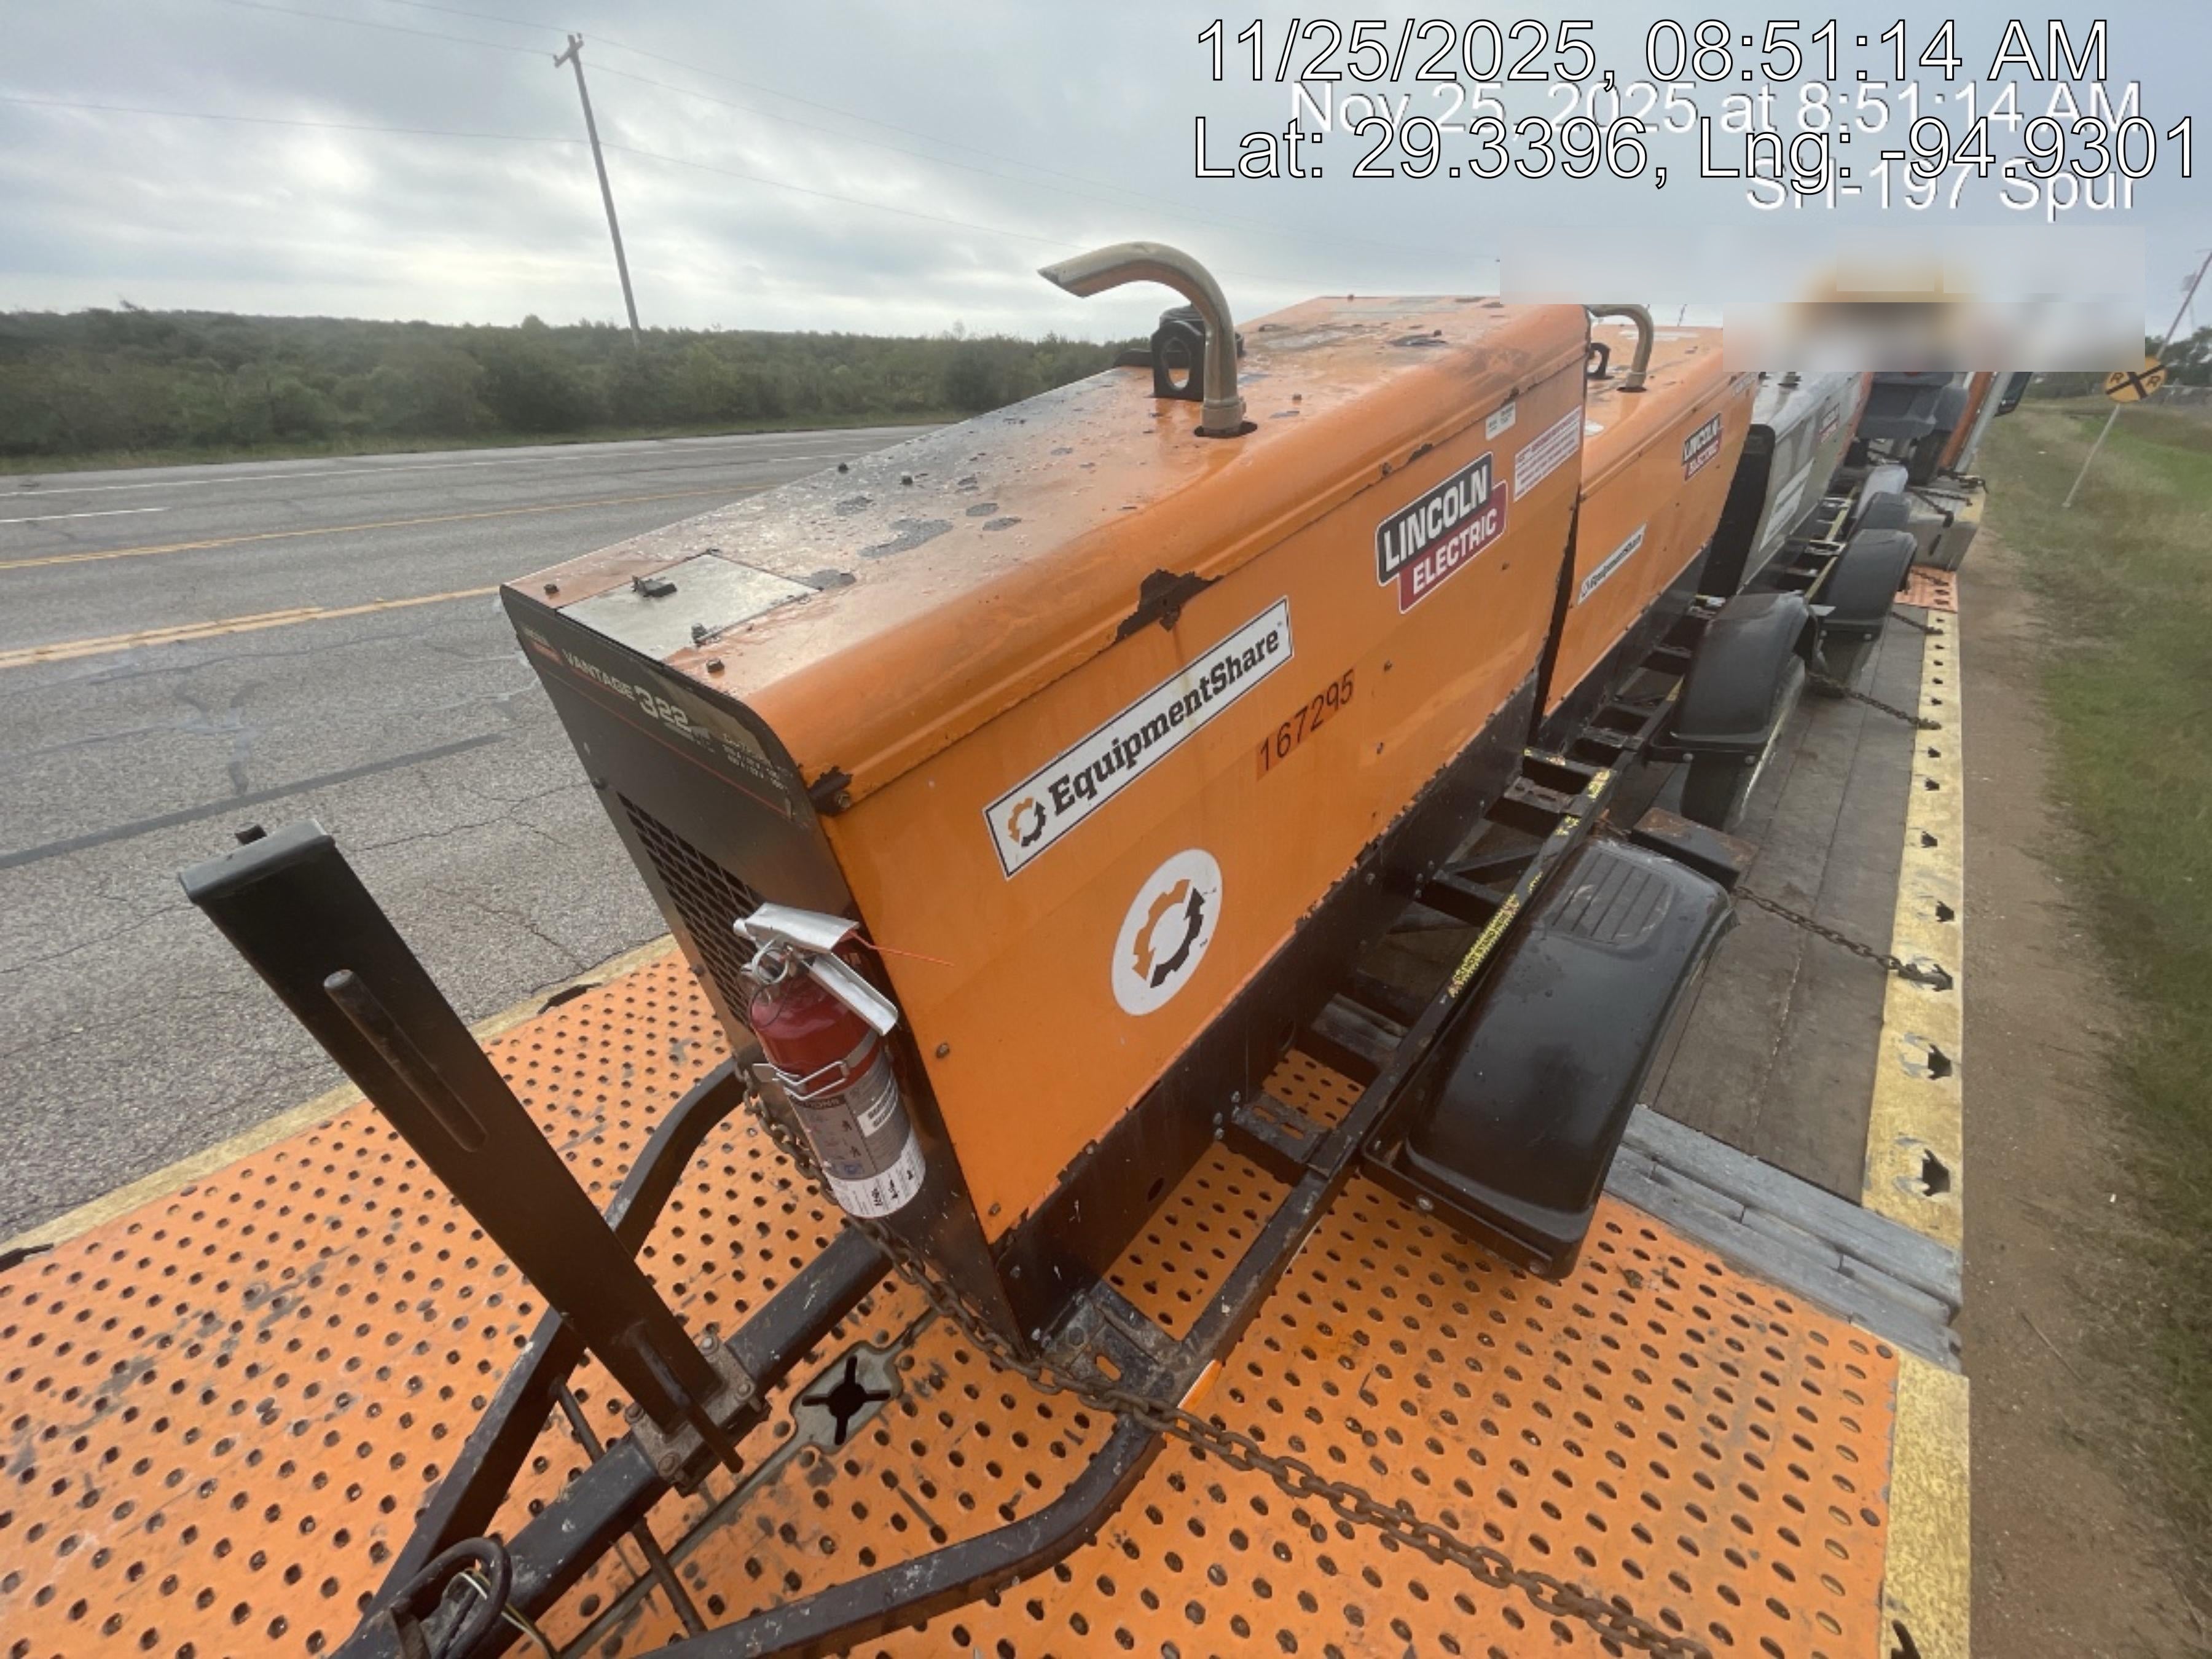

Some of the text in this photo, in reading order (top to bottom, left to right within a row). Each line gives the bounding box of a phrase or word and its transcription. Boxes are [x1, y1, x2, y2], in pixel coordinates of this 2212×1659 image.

[1384, 465, 1489, 571] LINCOLN
[1413, 508, 1497, 595] ELECTRIC
[634, 685, 692, 732] 322
[1048, 628, 1280, 817] EquipmentShare
[1260, 669, 1354, 771] 167295
